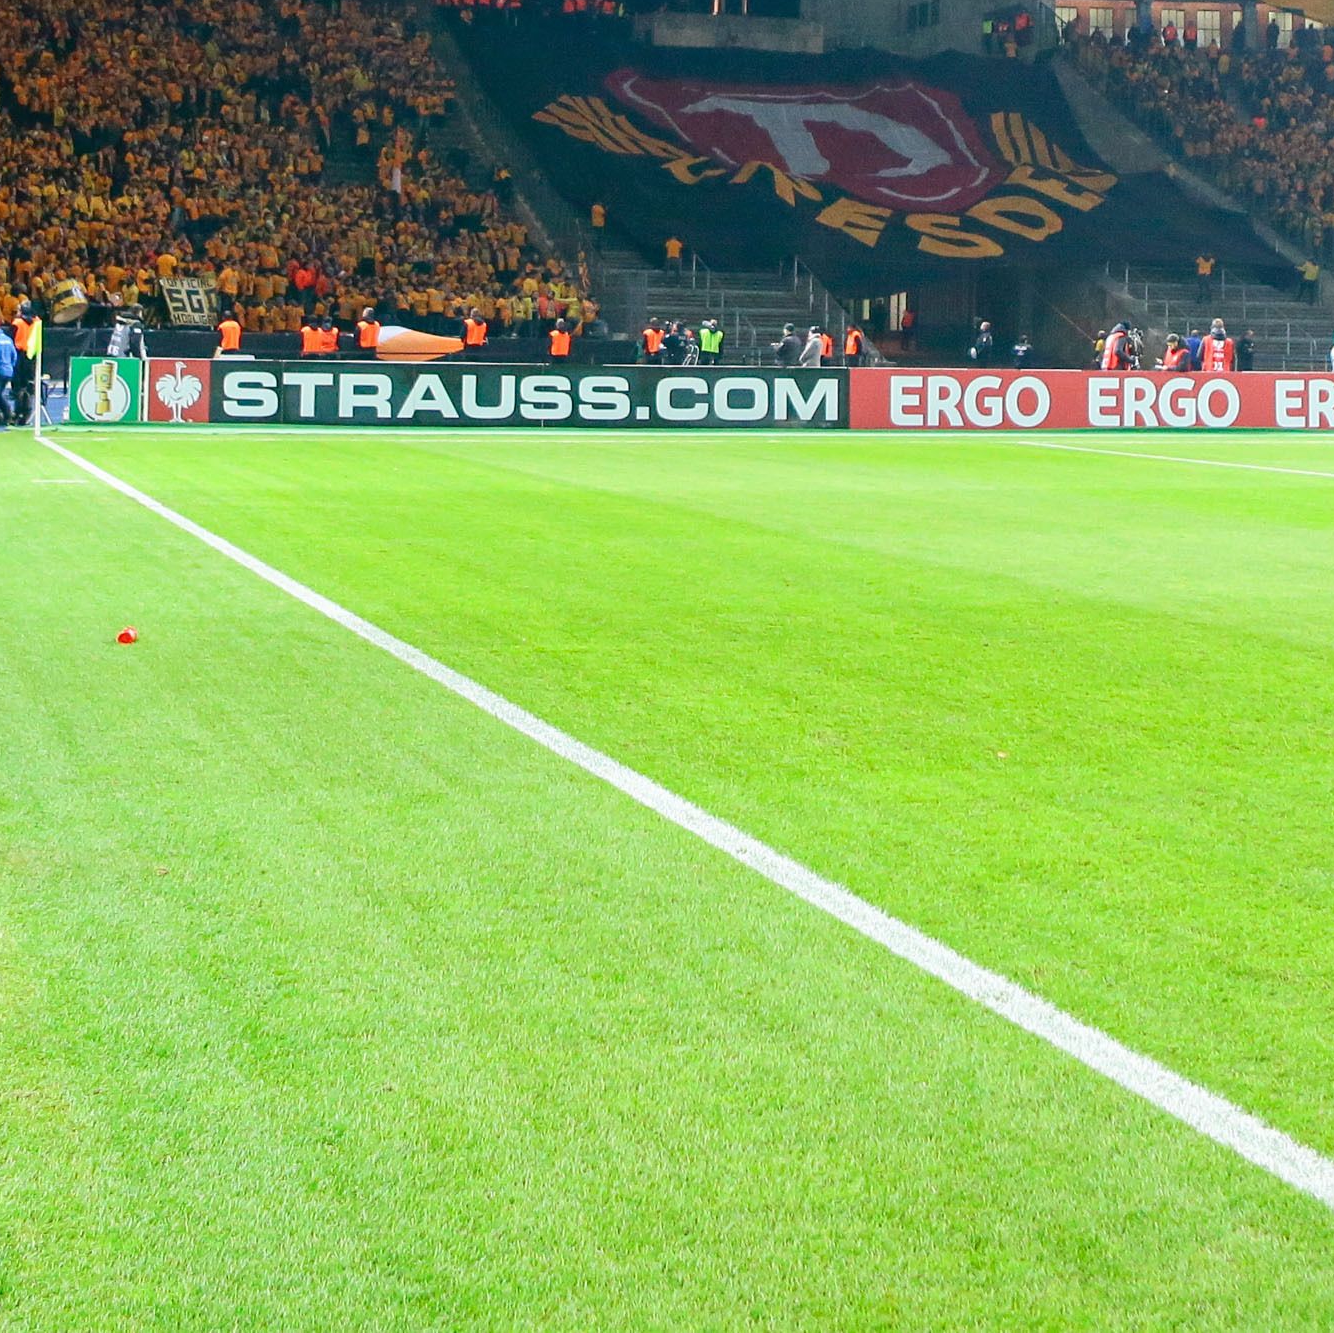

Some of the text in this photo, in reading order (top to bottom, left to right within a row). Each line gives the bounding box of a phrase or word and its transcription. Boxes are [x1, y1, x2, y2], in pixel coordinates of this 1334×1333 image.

[222, 370, 839, 420] STRAUSS.COM
[889, 374, 1051, 428] ERGO
[1087, 377, 1241, 428] ERGO
